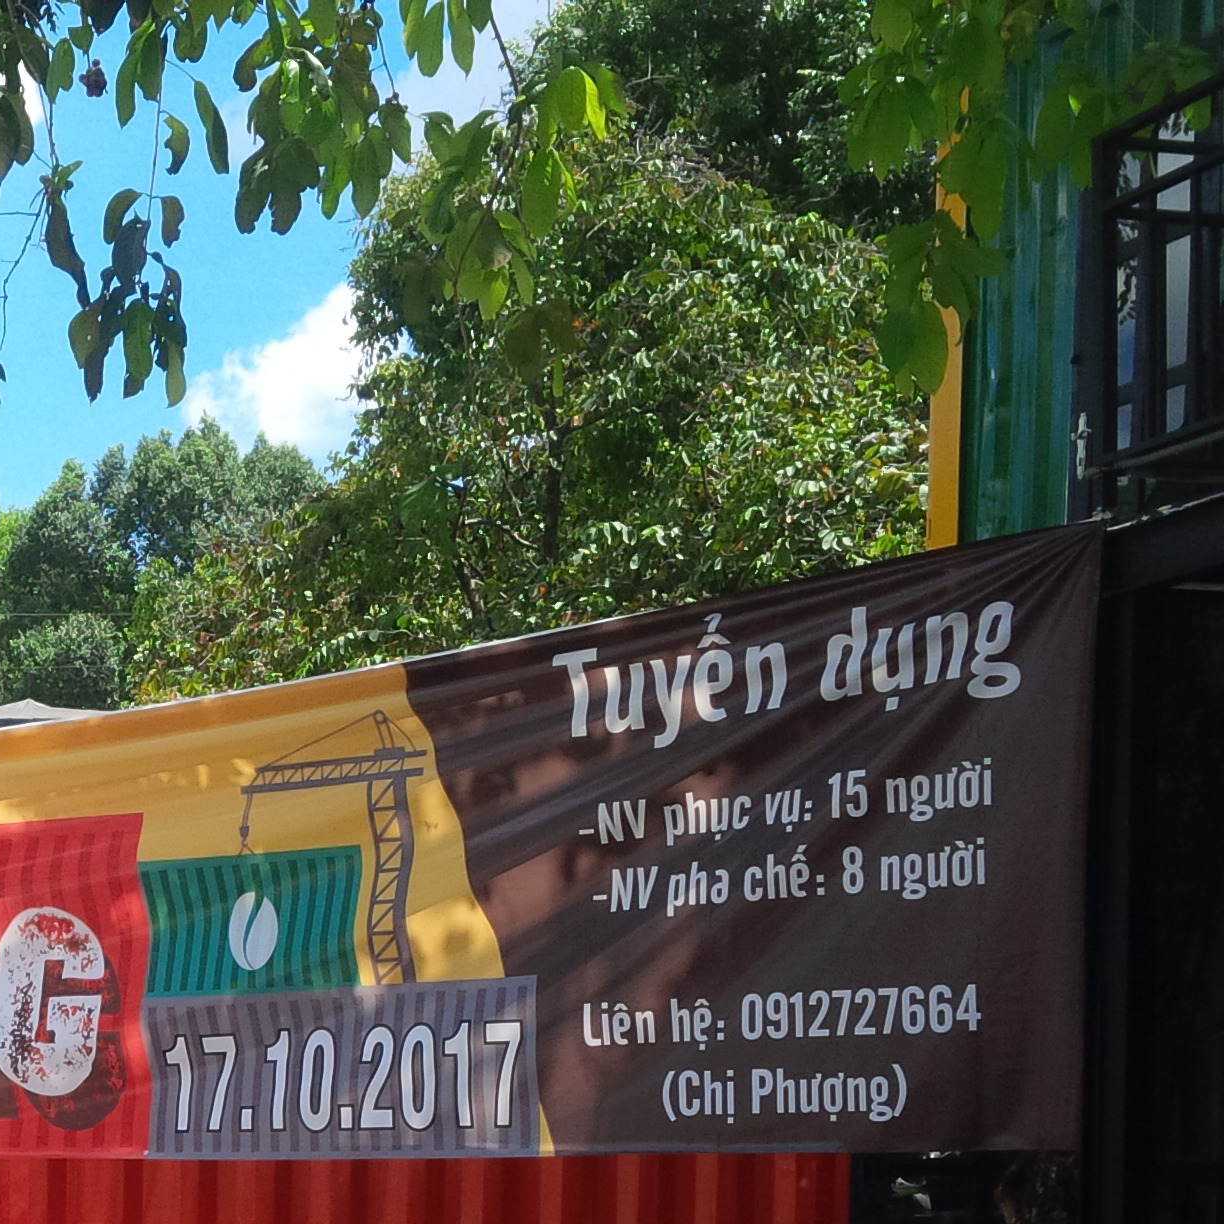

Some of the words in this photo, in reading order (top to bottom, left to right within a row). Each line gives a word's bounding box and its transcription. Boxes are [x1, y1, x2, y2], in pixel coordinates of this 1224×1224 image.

[552, 613, 788, 748] Tuyển
[820, 601, 1022, 711] dụng
[579, 799, 647, 844] -NV
[663, 792, 750, 846] phục
[764, 787, 813, 832] vụ:
[828, 769, 868, 819] 15
[886, 757, 992, 822] người
[593, 865, 659, 913] -NV
[666, 861, 729, 917] pha
[743, 844, 825, 900] chế:
[842, 846, 864, 894] 8
[880, 837, 986, 899] người
[583, 1002, 656, 1047] Liên
[670, 998, 725, 1051] hệ:
[741, 984, 982, 1040] 0912727664
[165, 1019, 524, 1133] 17.10.2017
[663, 1069, 735, 1124] (Chị
[751, 1063, 908, 1122] Phượng)
